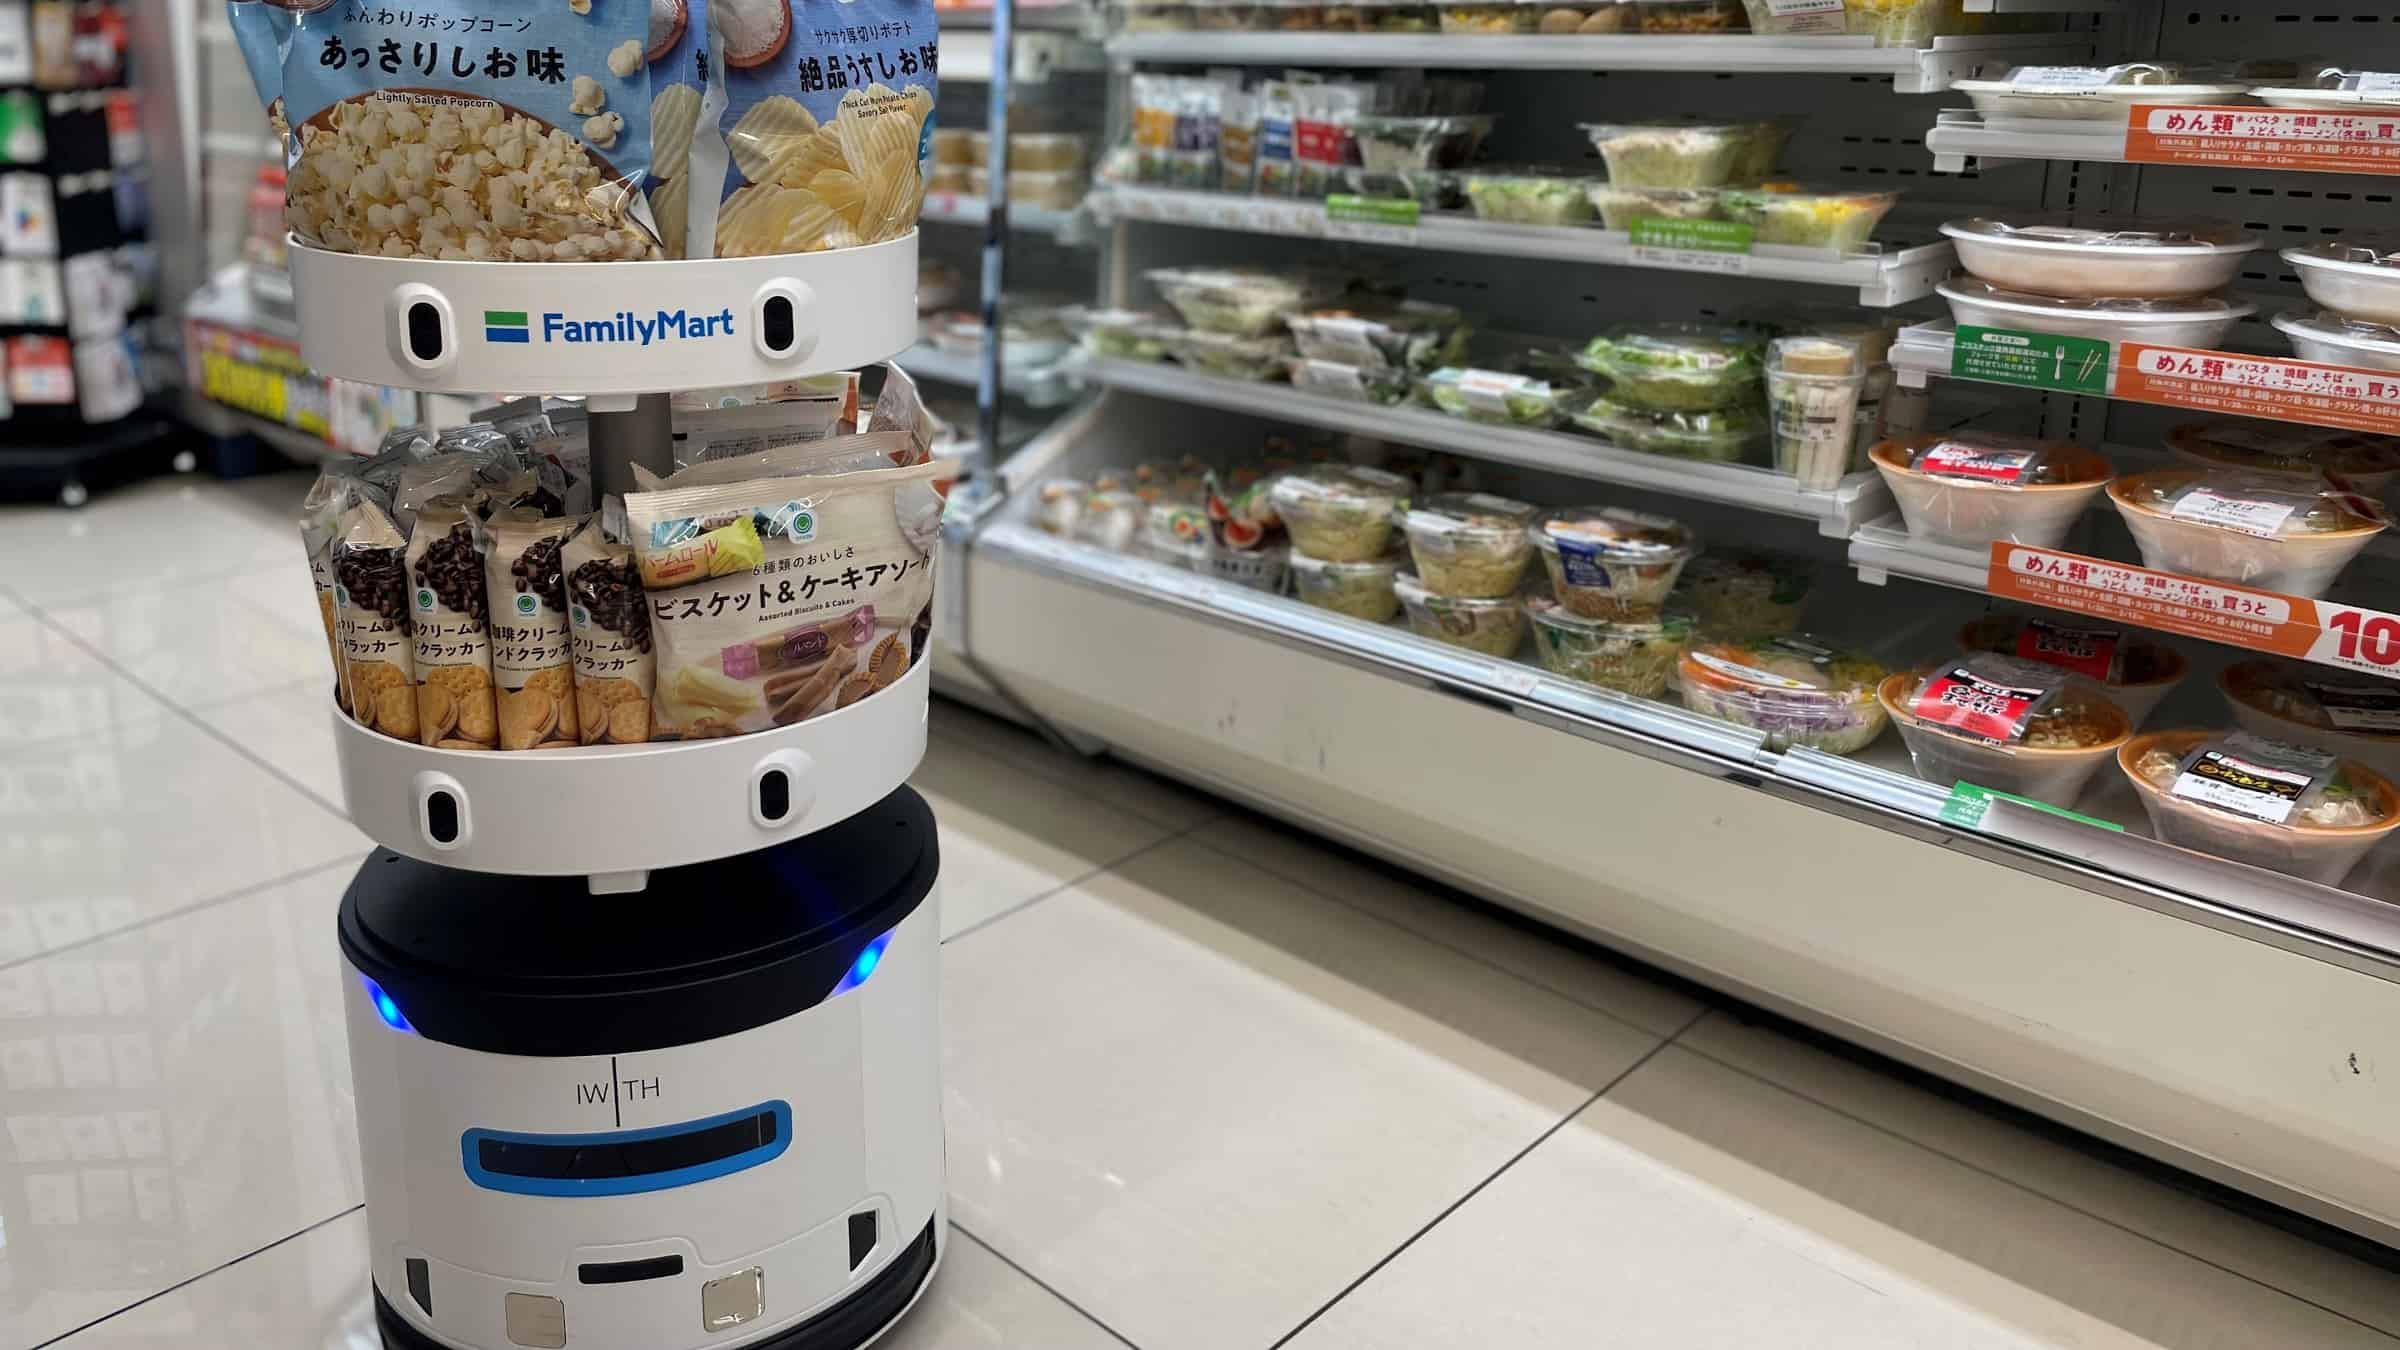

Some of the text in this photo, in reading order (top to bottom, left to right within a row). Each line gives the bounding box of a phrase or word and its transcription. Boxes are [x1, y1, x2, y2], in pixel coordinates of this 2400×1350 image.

[343, 8, 532, 33] ふんわりポップコーン
[320, 35, 567, 84] あっさりしお味
[376, 93, 494, 109] Lightly Salted Popcorn
[543, 308, 734, 346] FamilyMart
[752, 546, 855, 576] 6種類のおいしさ
[759, 608, 792, 622] Assorted
[832, 598, 855, 608] Cakes
